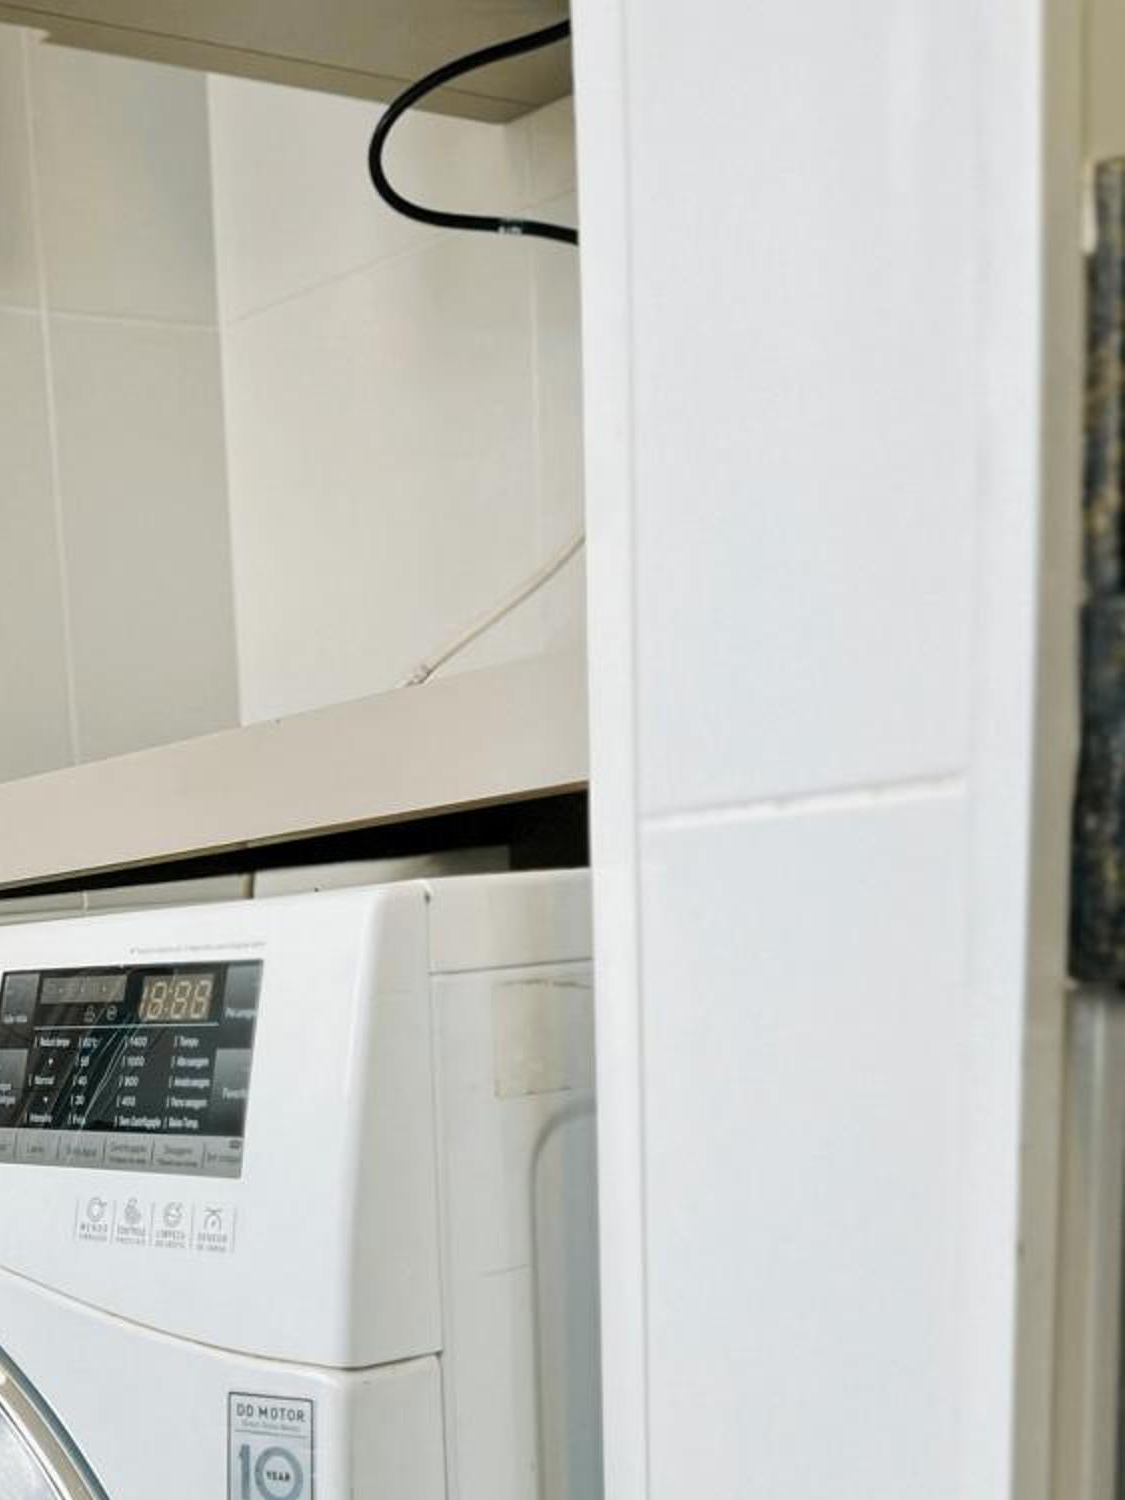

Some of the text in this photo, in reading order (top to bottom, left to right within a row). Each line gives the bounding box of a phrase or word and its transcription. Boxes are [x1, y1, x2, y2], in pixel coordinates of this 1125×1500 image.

[236, 1403, 305, 1423] DD MOTOR
[266, 1471, 290, 1483] YEAR
